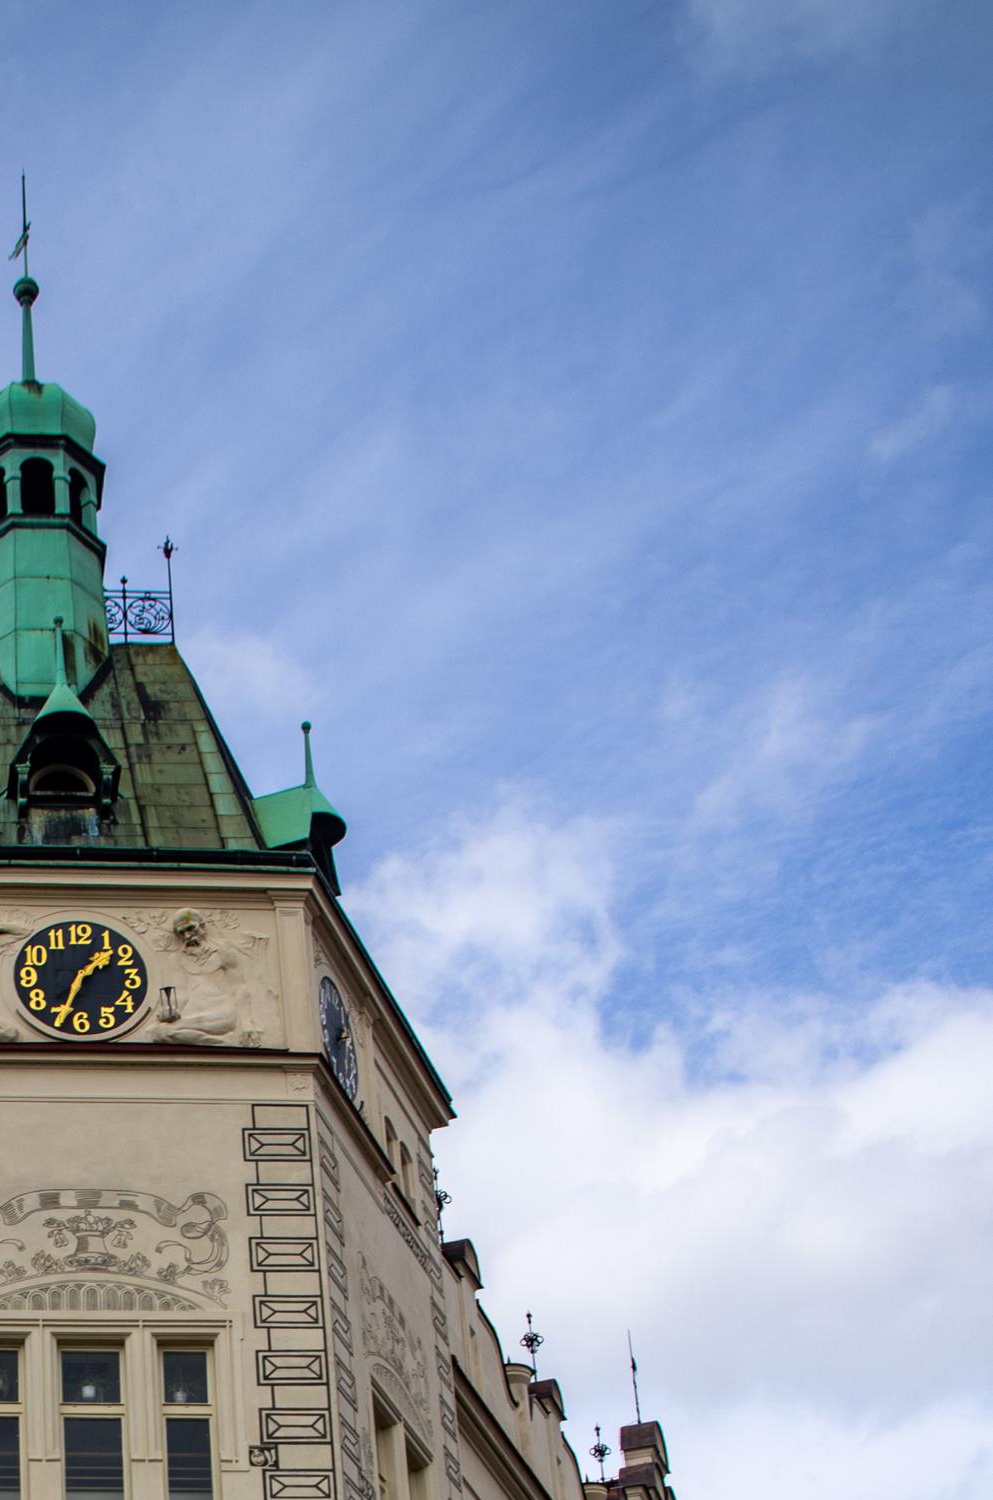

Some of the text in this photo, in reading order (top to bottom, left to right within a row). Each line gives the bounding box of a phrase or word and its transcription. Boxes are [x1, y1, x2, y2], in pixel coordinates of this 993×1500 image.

[48, 928, 65, 950] 11
[68, 924, 92, 945] 12
[102, 930, 112, 950] 1
[24, 944, 47, 966] 10
[117, 944, 134, 966] 2
[19, 966, 37, 988] 9
[124, 967, 142, 989] 3
[29, 988, 47, 1011] 8
[115, 990, 134, 1013] 4
[72, 1011, 90, 1033] 6
[98, 1006, 116, 1028] 5
